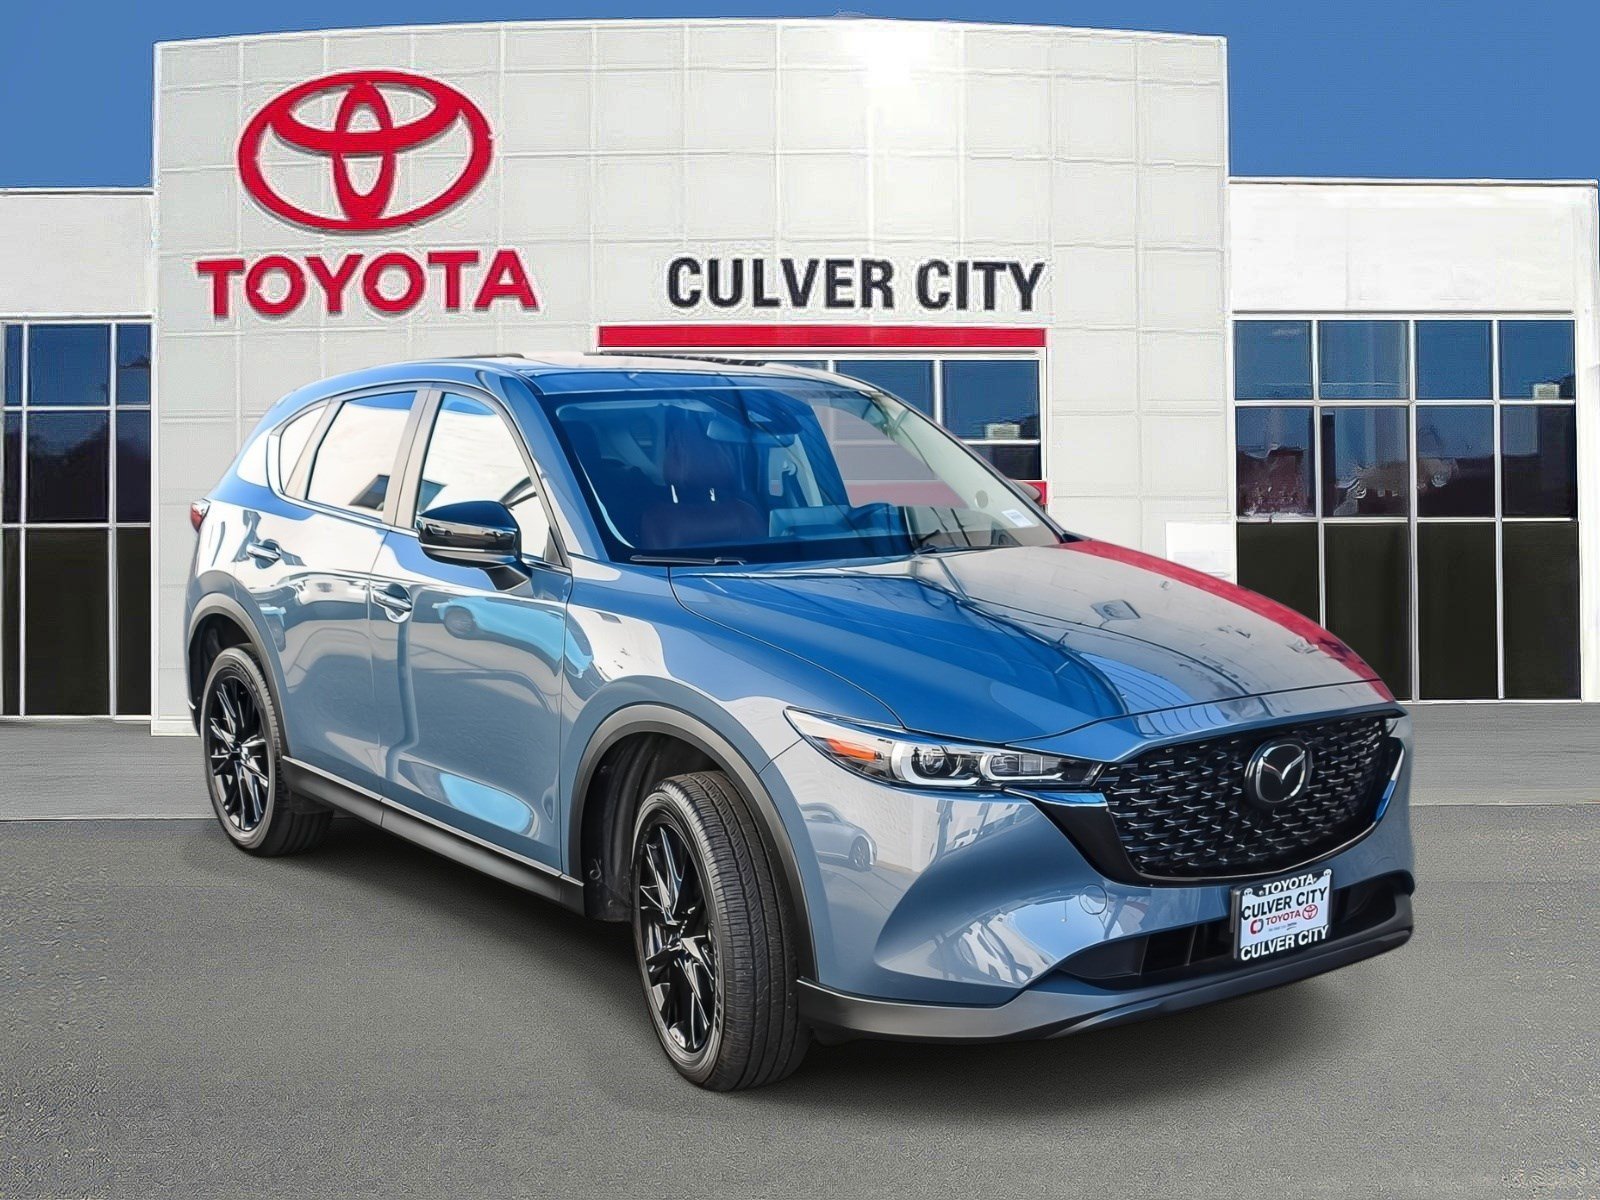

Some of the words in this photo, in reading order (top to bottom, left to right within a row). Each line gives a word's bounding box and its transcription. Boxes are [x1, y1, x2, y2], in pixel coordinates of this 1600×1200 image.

[197, 249, 538, 318] TOYOTA
[667, 256, 895, 309] CULVER
[915, 259, 1046, 311] CITY
[1262, 873, 1314, 896] TOYOTA
[1241, 895, 1292, 921] CULVER
[1296, 886, 1329, 907] CITY
[1265, 909, 1301, 926] TOYOTA
[1241, 934, 1295, 961] CULVER
[1298, 924, 1330, 946] CITY
